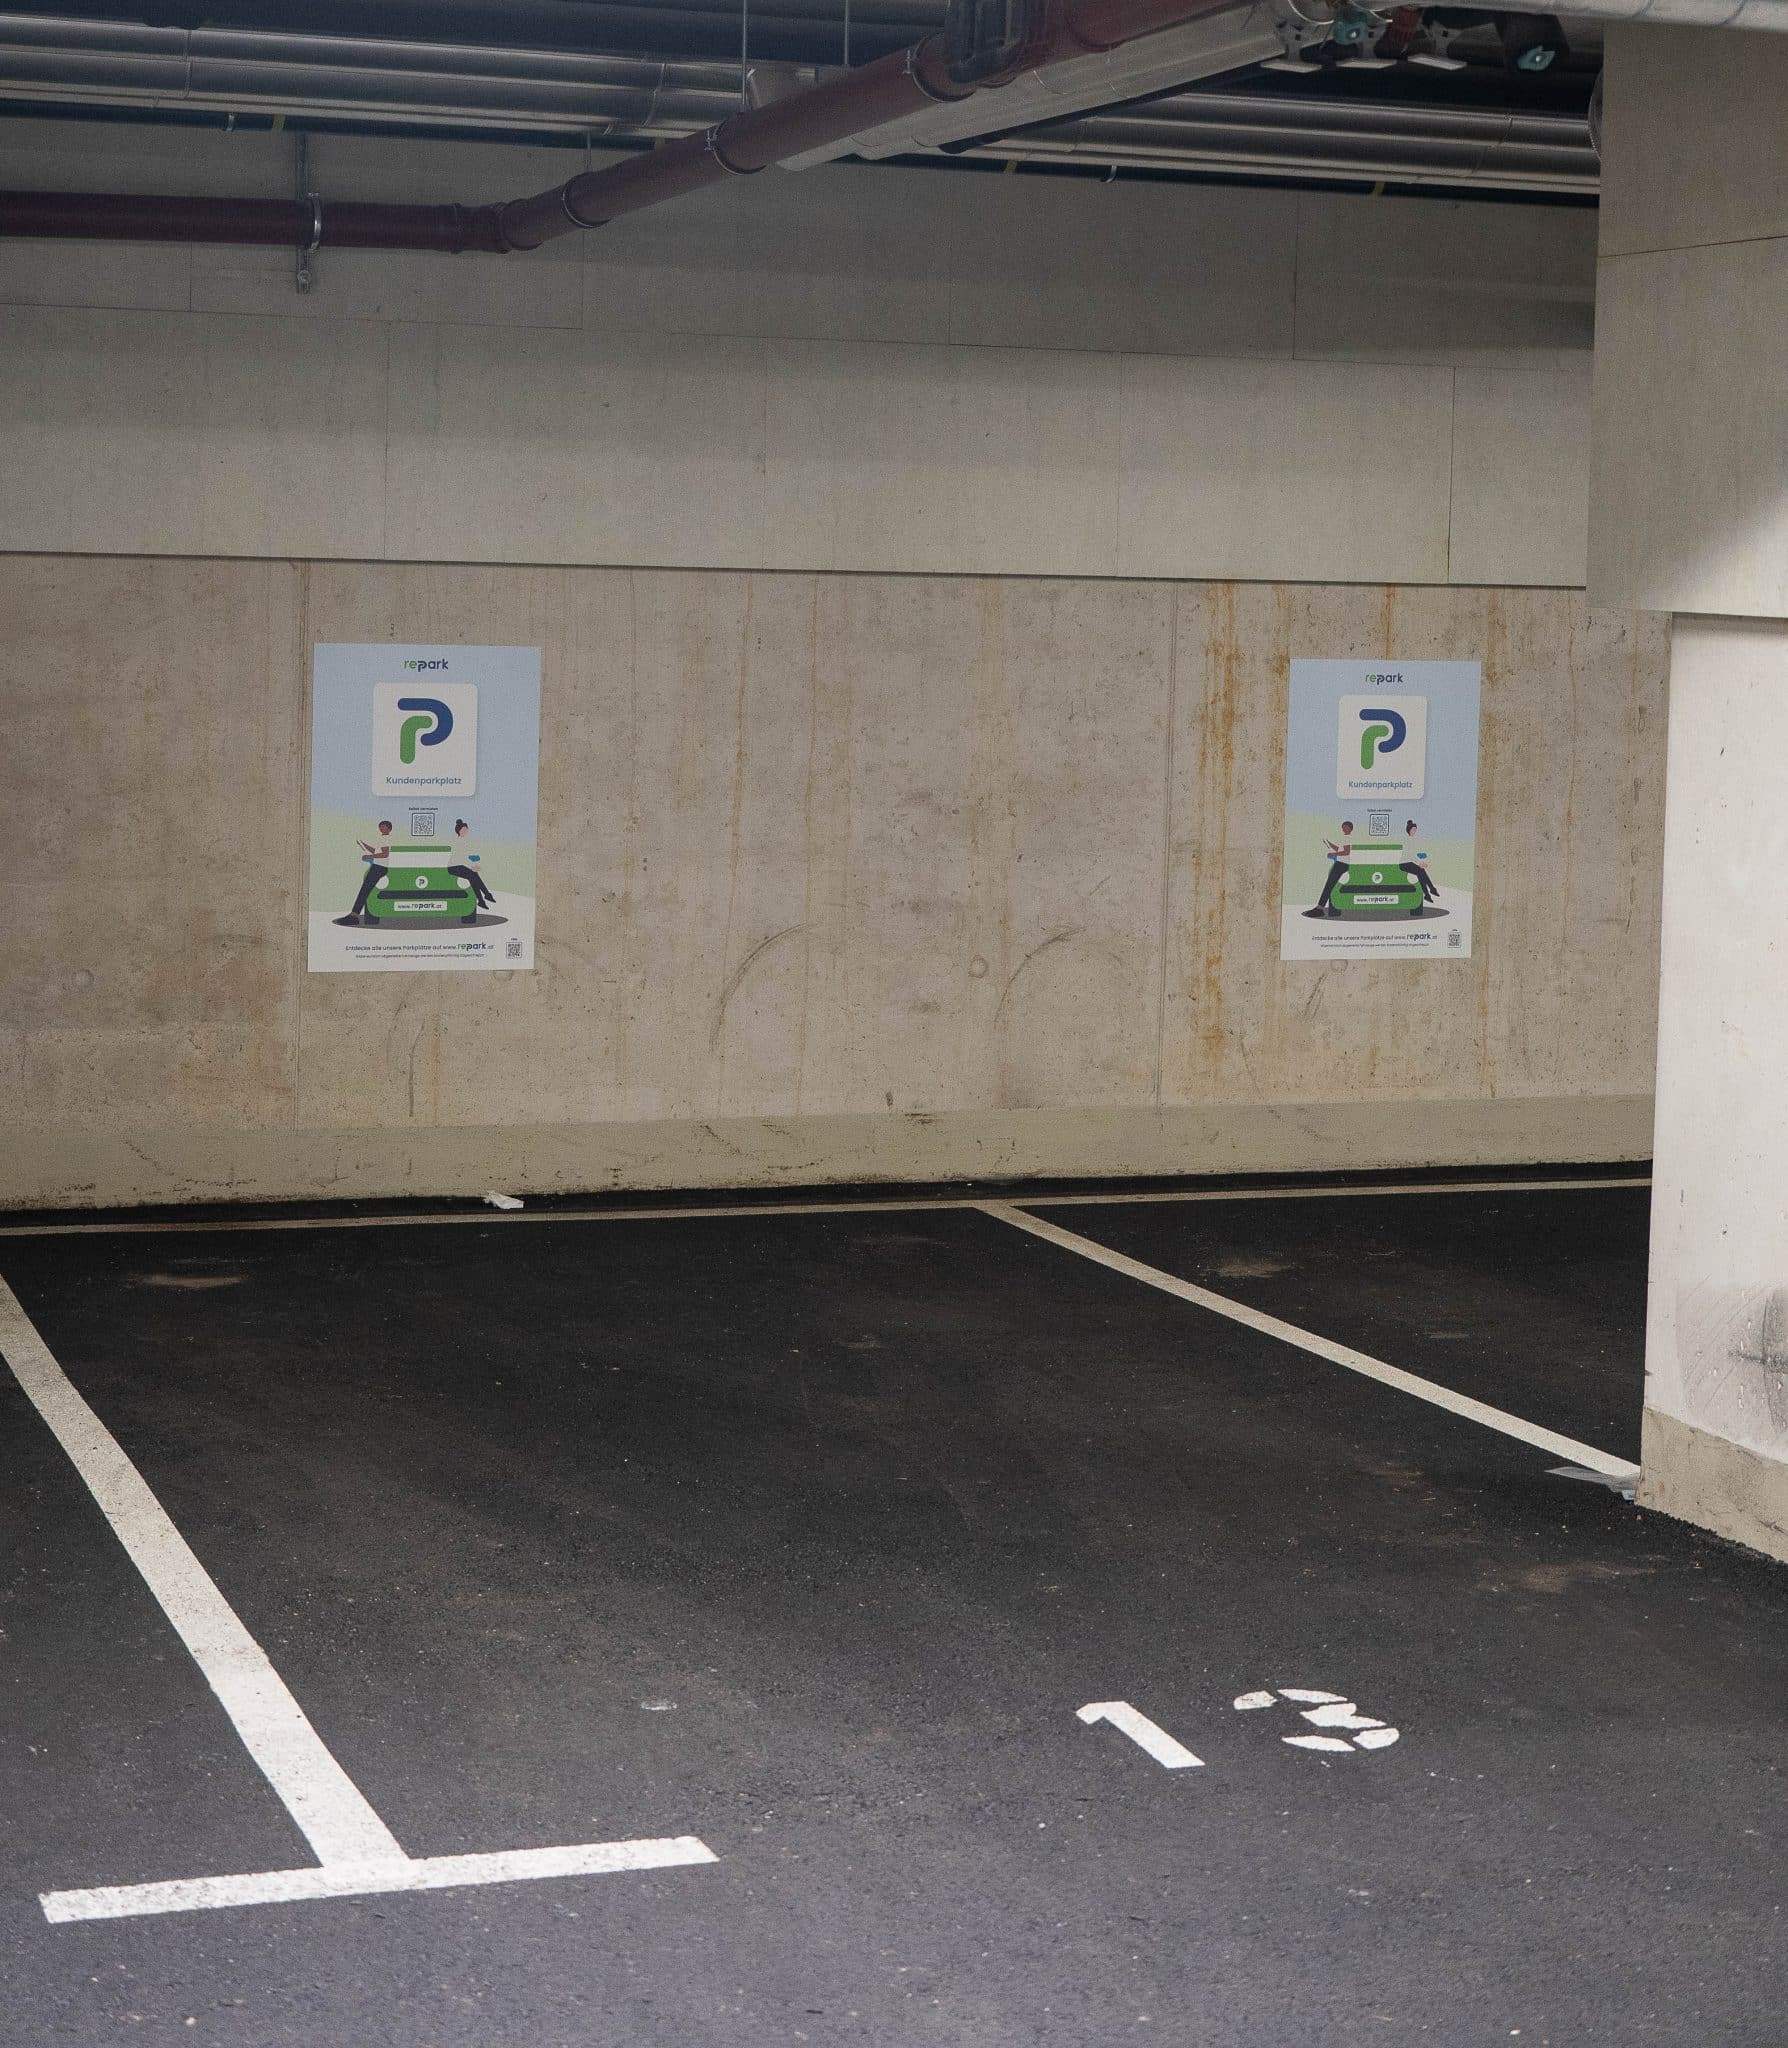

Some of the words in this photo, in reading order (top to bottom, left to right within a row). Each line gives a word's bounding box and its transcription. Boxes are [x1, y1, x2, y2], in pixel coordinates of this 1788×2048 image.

[404, 658, 449, 673] repark
[1365, 672, 1404, 686] repark
[385, 776, 462, 786] Kundenparkplatz
[1348, 780, 1413, 790] Kundenparkplatz
